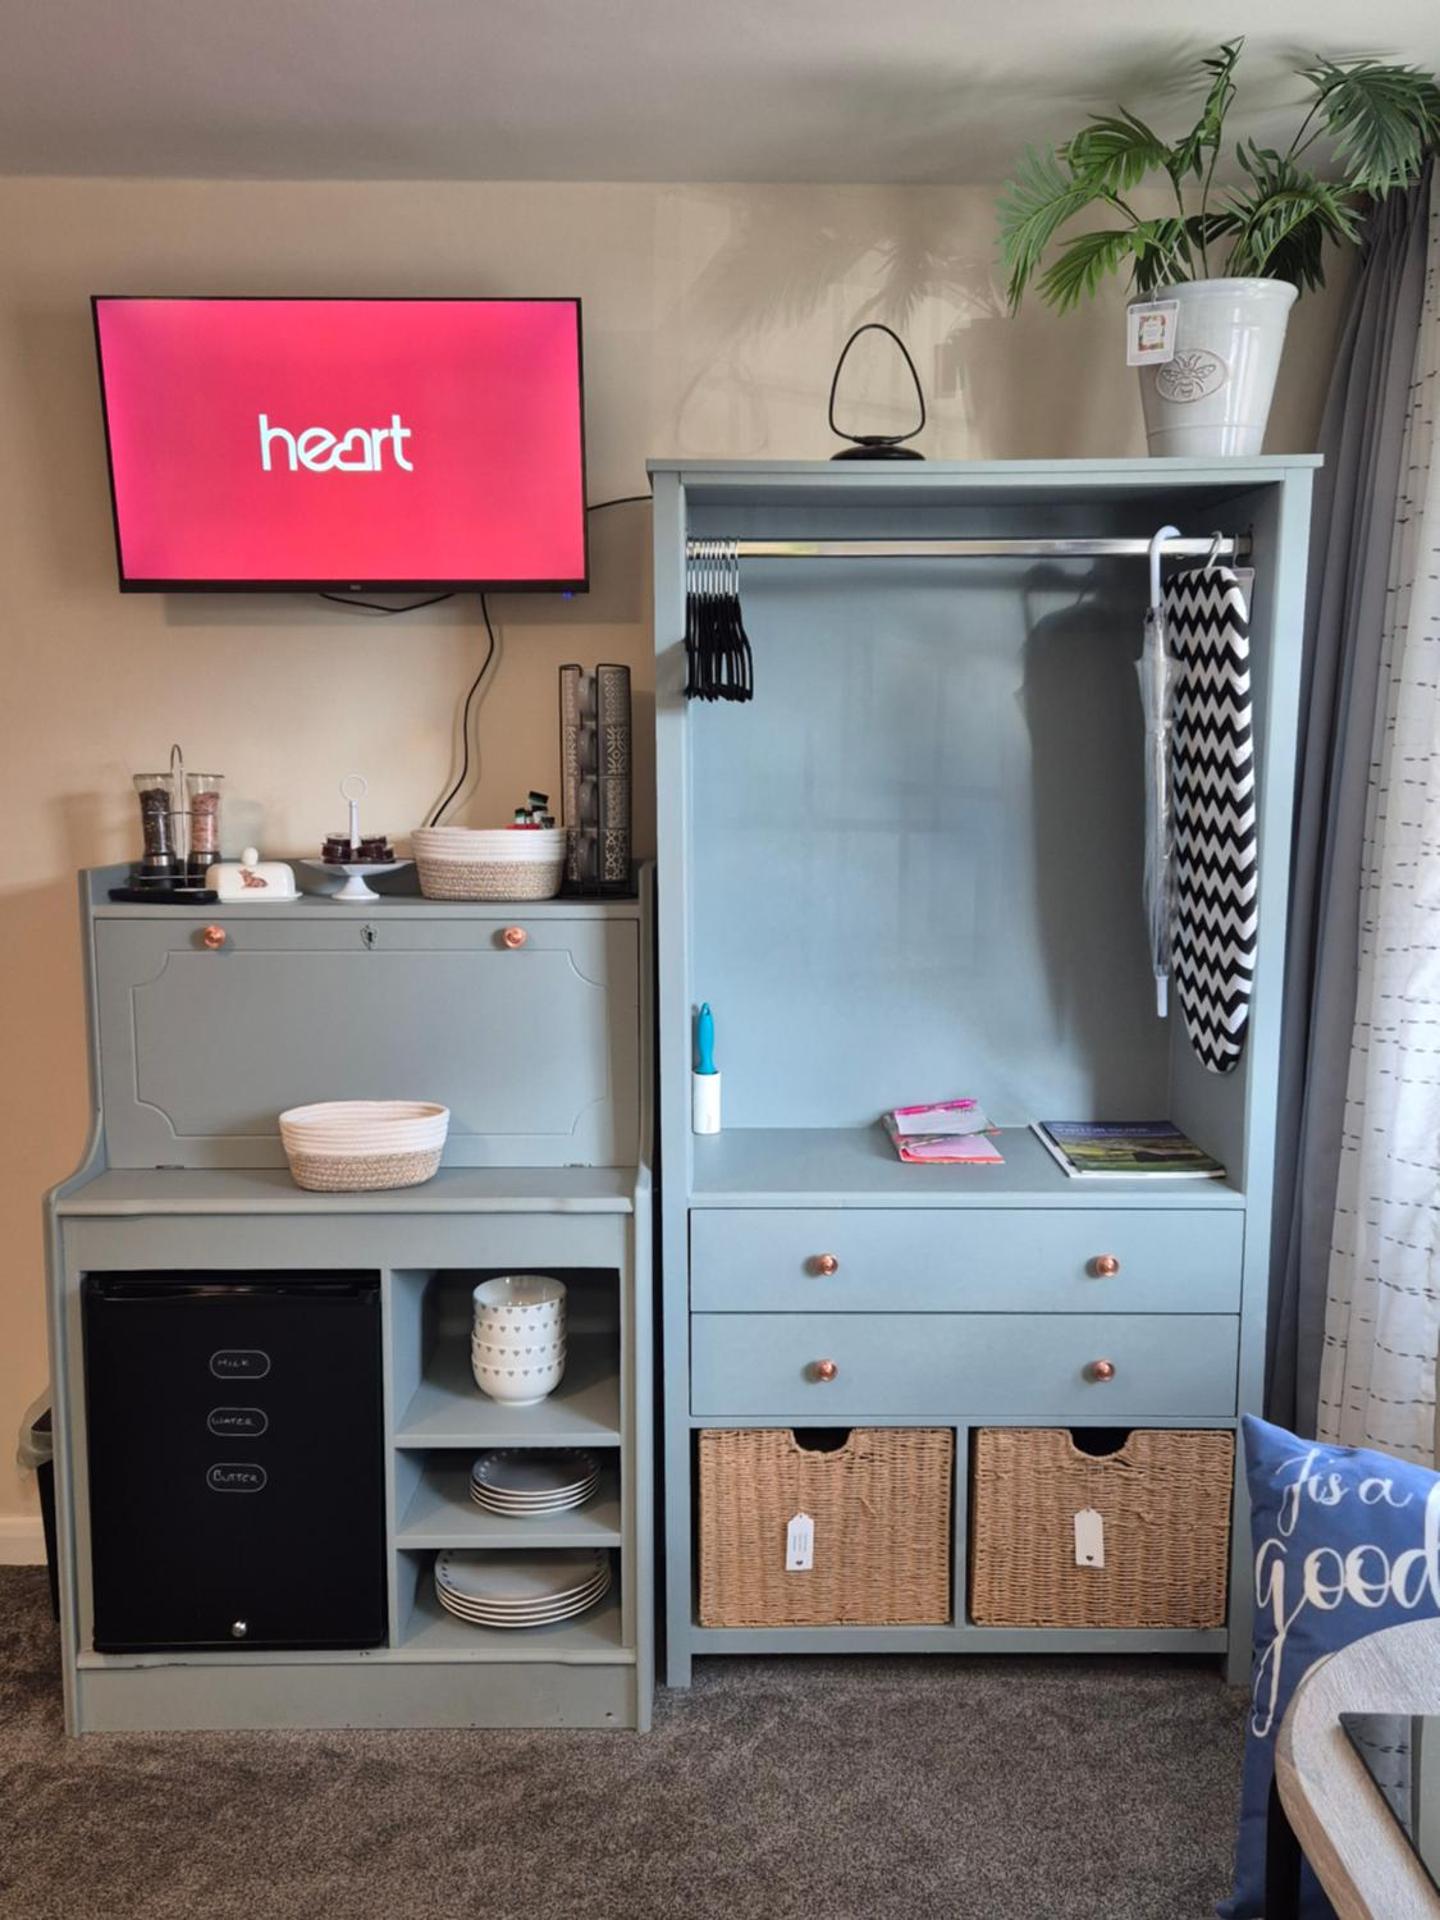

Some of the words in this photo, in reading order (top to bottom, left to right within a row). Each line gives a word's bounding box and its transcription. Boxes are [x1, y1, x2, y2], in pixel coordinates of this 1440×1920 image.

[258, 413, 414, 472] heart
[1358, 1476, 1413, 1508] a
[1251, 1480, 1440, 1738] good
